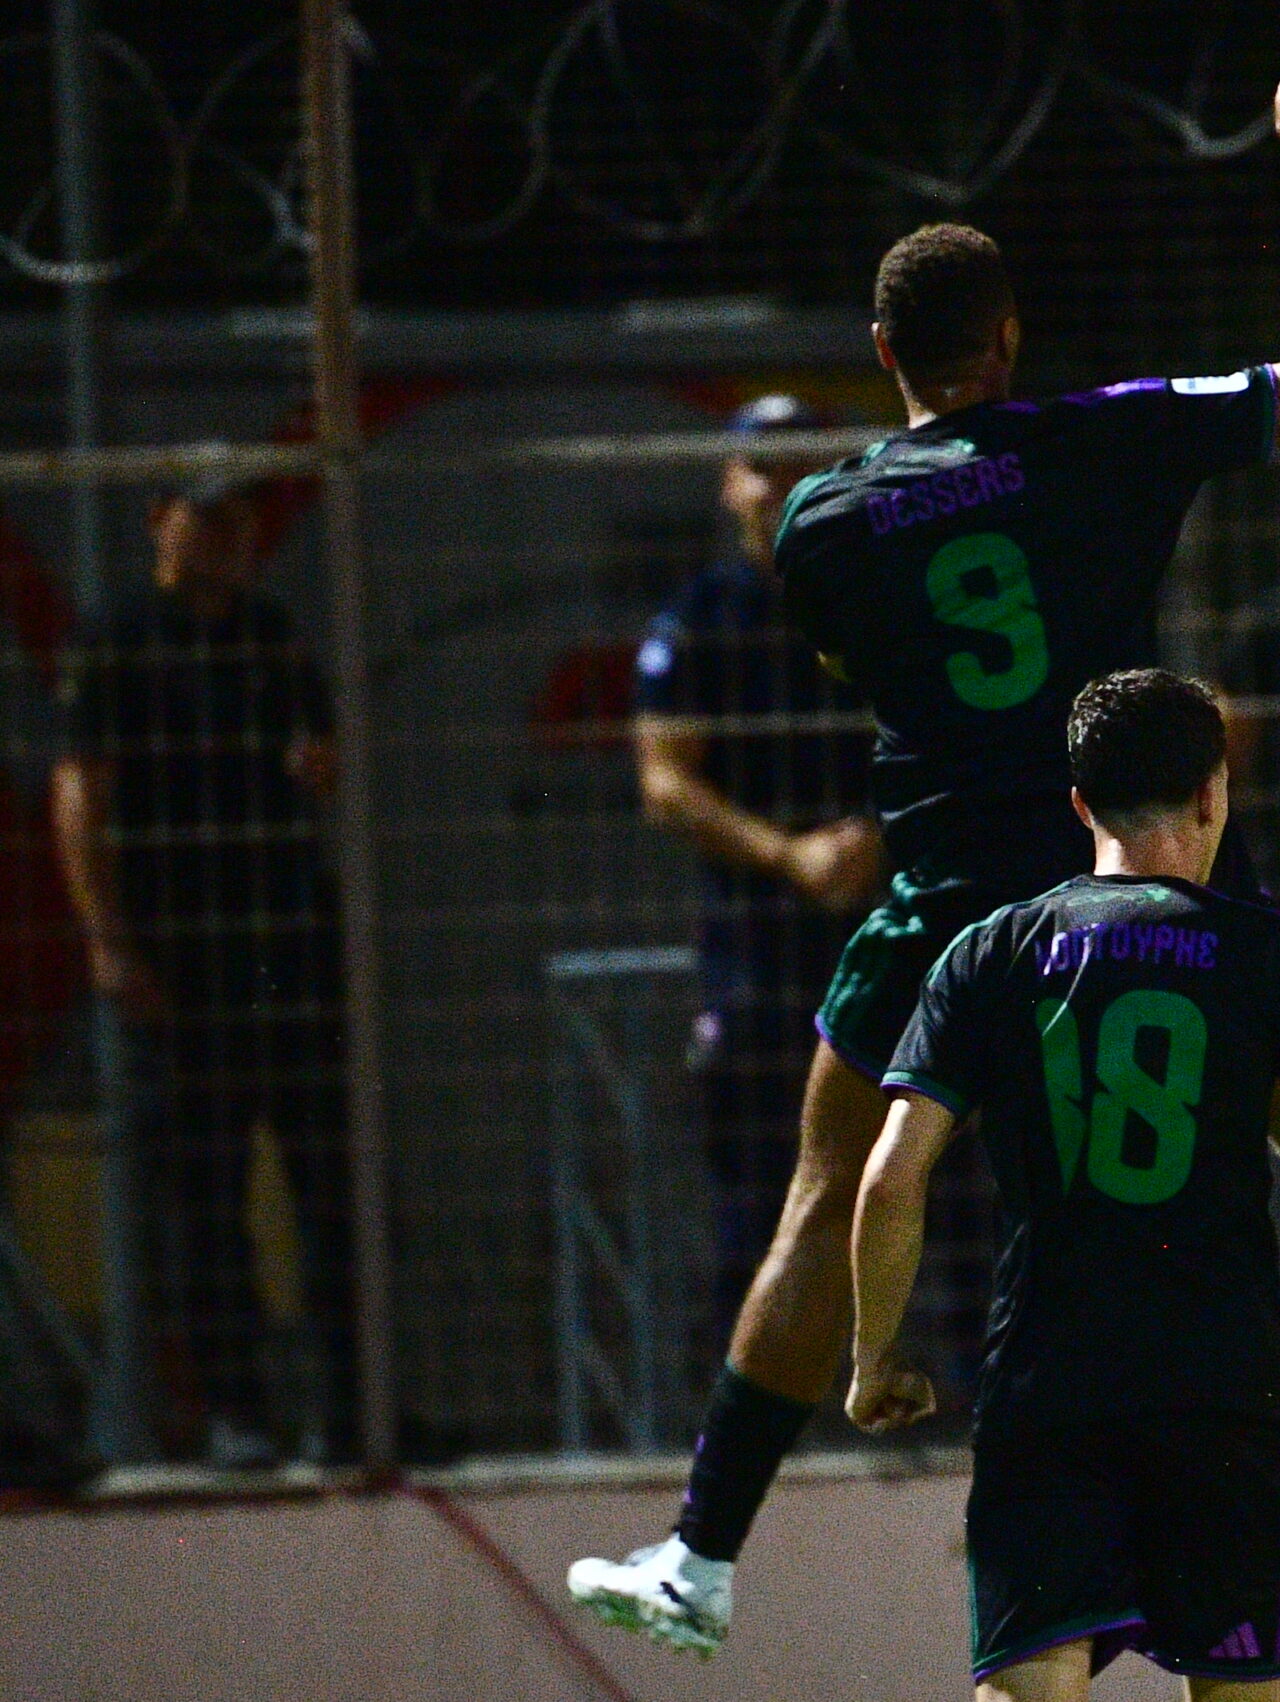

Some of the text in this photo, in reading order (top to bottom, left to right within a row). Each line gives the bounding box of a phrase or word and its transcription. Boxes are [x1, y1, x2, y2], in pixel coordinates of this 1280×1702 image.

[866, 452, 1025, 535] DESSERS
[925, 531, 1050, 712] 9
[1035, 988, 1209, 1205] 18
